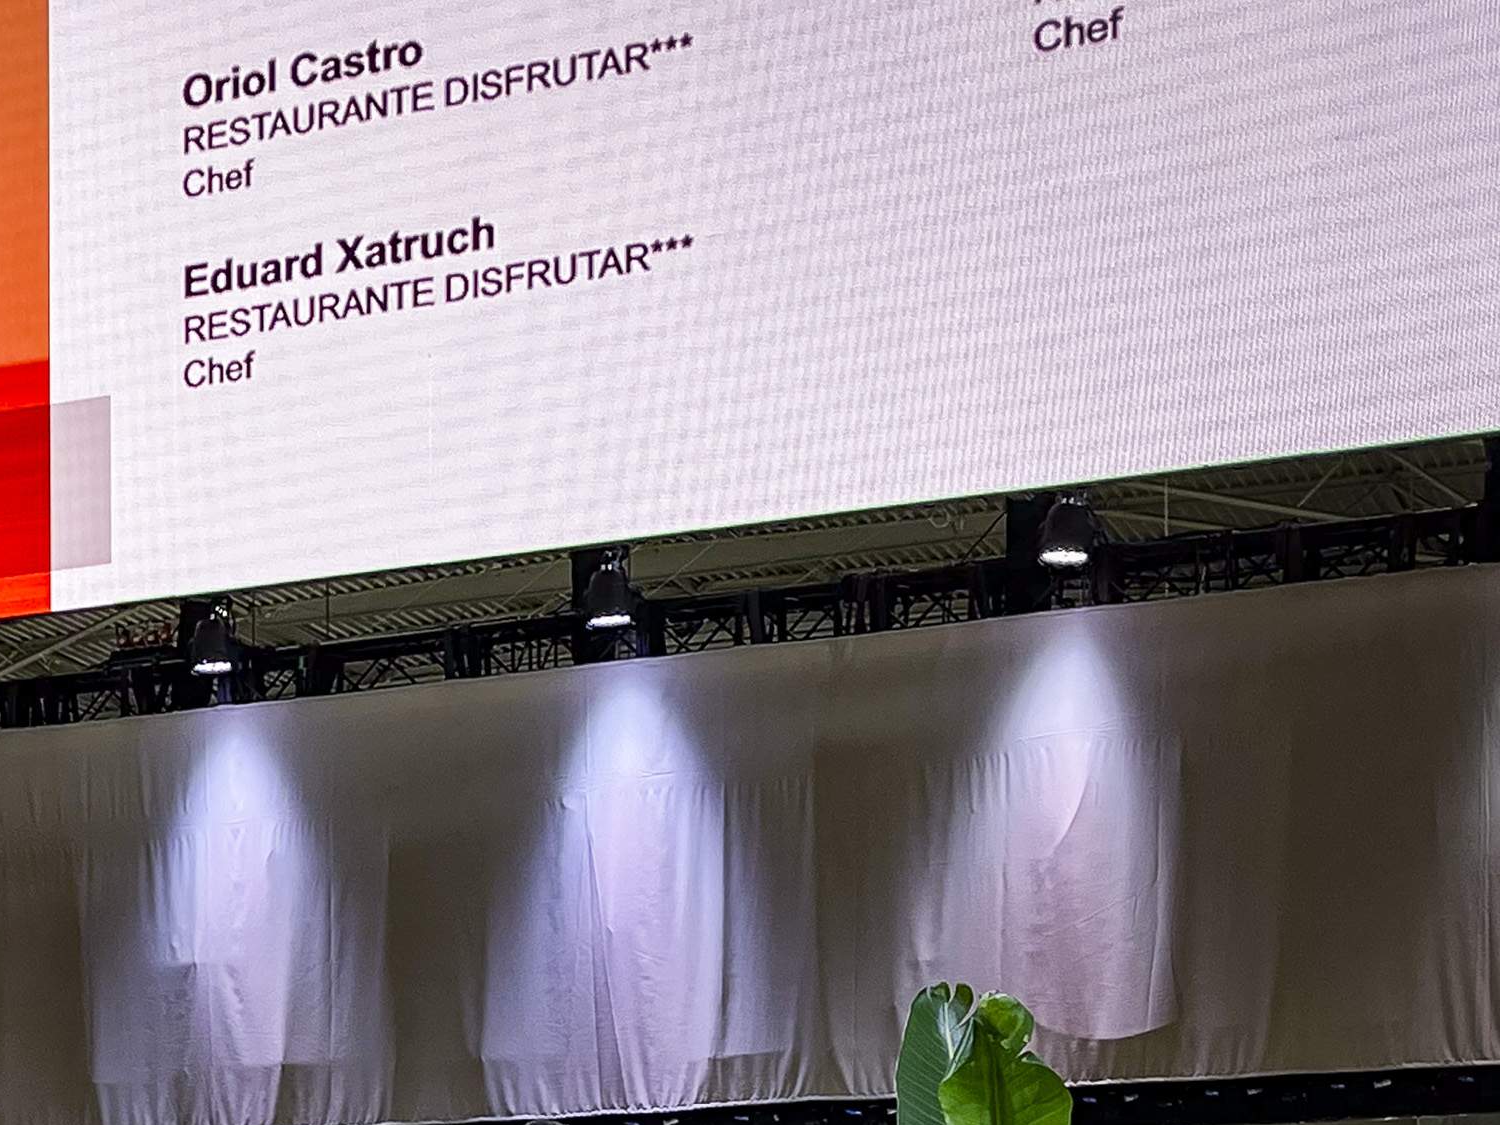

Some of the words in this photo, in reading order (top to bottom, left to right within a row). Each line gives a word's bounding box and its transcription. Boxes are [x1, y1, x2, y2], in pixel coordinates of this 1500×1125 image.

[1033, 6, 1124, 53] Chef
[182, 59, 277, 107] Oriol
[289, 38, 423, 88] Castro
[183, 81, 435, 154] RESTAURANTE
[183, 159, 254, 197] Chef
[184, 243, 323, 298] Eduard
[335, 216, 496, 273] Xatruch
[183, 276, 435, 344] RESTAURANTE
[183, 350, 254, 389] Chef
